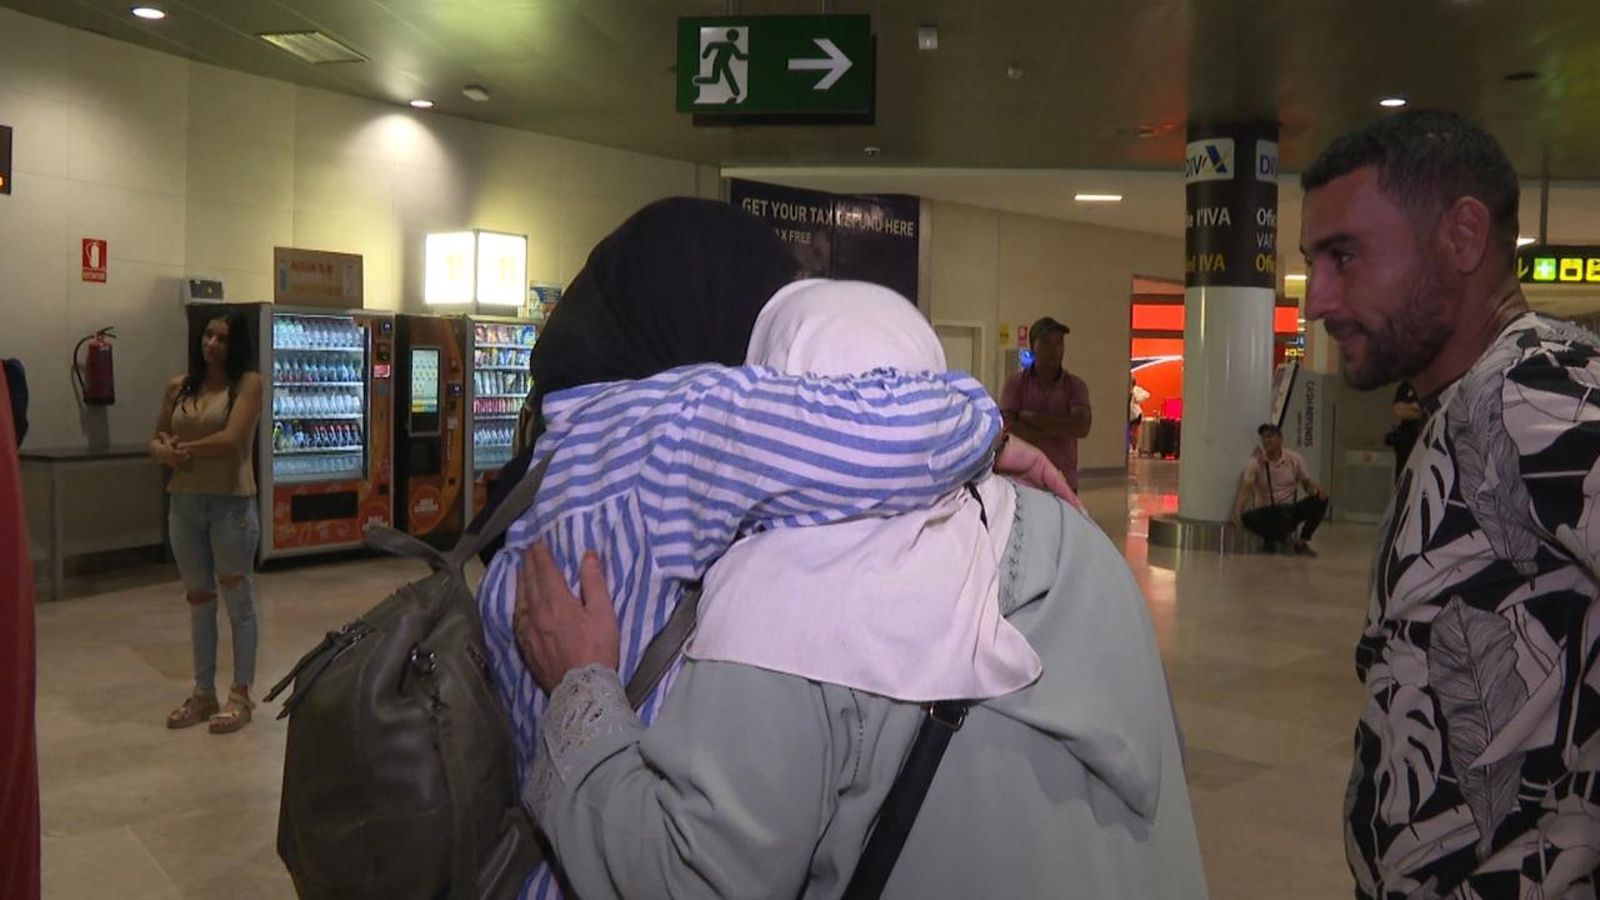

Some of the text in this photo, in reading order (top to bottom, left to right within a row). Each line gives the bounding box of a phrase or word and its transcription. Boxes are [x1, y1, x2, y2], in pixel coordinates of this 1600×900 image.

[742, 197, 769, 217] GET
[770, 201, 808, 222] YOUR
[809, 207, 833, 226] TAX
[885, 217, 915, 237] HERE
[789, 229, 813, 244] FREE
[1199, 253, 1226, 272] IVA
